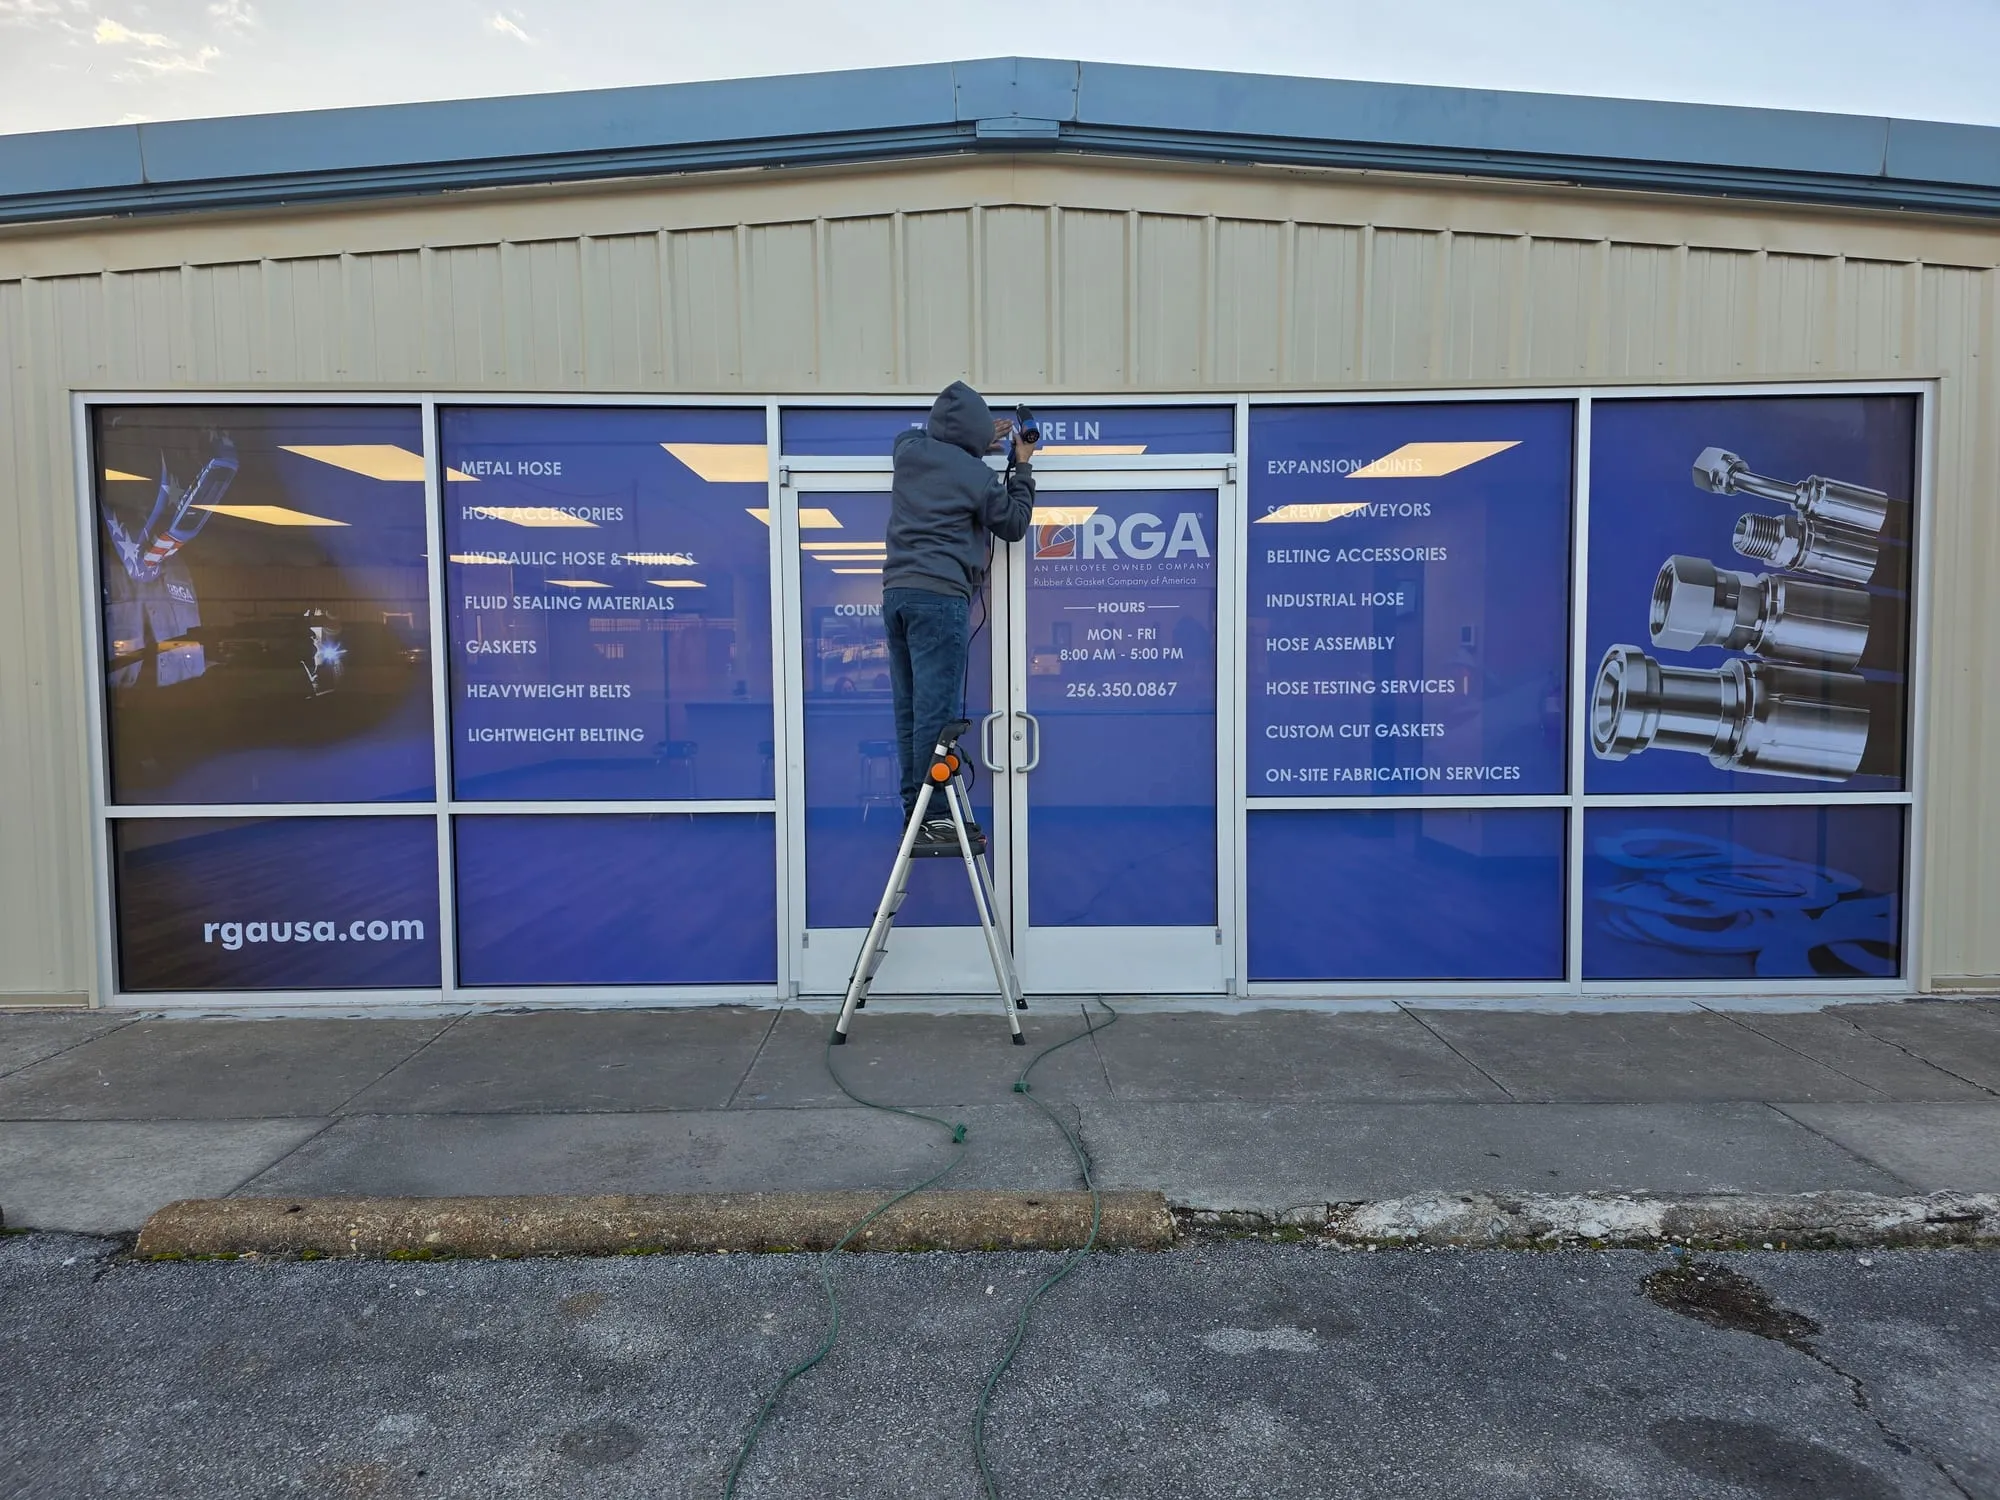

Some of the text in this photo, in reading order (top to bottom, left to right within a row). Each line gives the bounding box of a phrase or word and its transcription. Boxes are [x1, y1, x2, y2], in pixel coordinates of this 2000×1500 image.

[1074, 421, 1100, 441] LN
[460, 460, 562, 476] METAL HOSE
[1267, 457, 1423, 475] EXPANSION JOINTS
[461, 506, 624, 521] HOSE ACCESSORIES
[1266, 502, 1432, 519] SCREW CONVEYORS
[1082, 512, 1211, 560] RGA
[463, 551, 694, 566] HYDRAULIC HOSE & FITTINGS
[1266, 547, 1448, 564] BELTING ACCESSORIES
[1033, 562, 1211, 573] AN EMPLOYEE OWNED COMPANY
[1033, 576, 1197, 588] Rubber & Gasket Company of America
[464, 596, 675, 611] FLUID SEALING MATERIALS
[1097, 601, 1146, 614] HOURS
[1265, 592, 1405, 608] INDUSTRIAL HOSE
[834, 603, 883, 617] COUN
[1087, 628, 1123, 641] MON
[1137, 628, 1156, 640] FRI
[465, 639, 538, 655] GASKETS
[1265, 636, 1396, 652] HOSE ASSEMBLY
[1059, 648, 1089, 661] 8:00
[1092, 648, 1117, 661] AM
[1129, 647, 1159, 660] 5:00
[1162, 647, 1184, 660] PM
[466, 684, 632, 699] HEAVYWEIGHT BELTS
[1066, 681, 1178, 698] 256.350.0867
[1265, 679, 1456, 695] HOSE TESTING SERVICES
[468, 727, 645, 743] LIGHTWEIGHT BELTING
[1265, 723, 1446, 739] CUSTOM CUT GASKETS
[1265, 765, 1521, 783] ON-SITE FABRICATION SERVICES
[203, 919, 425, 951] rgausa.com
